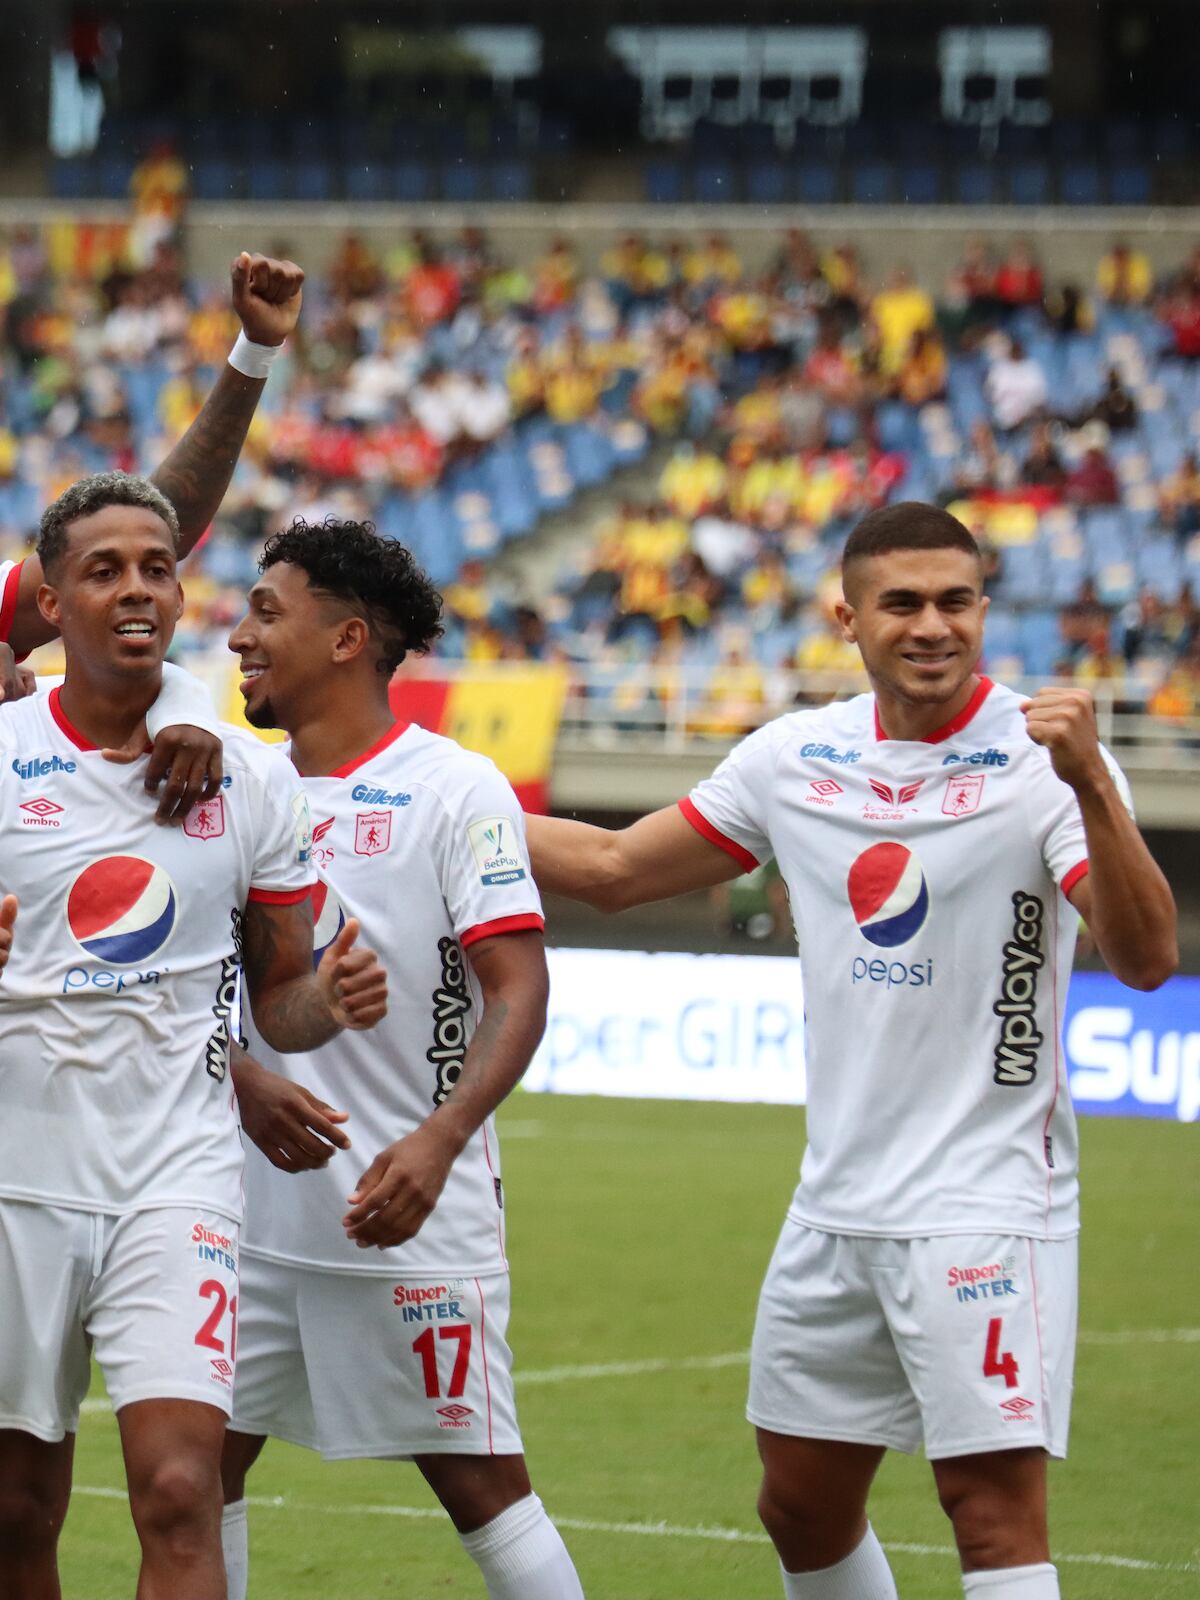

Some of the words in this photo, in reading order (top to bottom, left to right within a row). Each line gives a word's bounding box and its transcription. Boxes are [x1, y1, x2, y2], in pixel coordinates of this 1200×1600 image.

[351, 784, 412, 807] Gillette
[805, 795, 834, 807] umbro
[23, 817, 61, 828] umbro
[360, 817, 388, 827] América
[852, 956, 934, 990] pepsi
[994, 890, 1044, 1086] wplay.co
[547, 1010, 662, 1092] per
[677, 998, 792, 1070] GIR
[199, 1245, 238, 1276] INTER
[947, 1264, 1001, 1286] Super
[394, 1285, 447, 1306] Super
[957, 1279, 1020, 1302] INTER
[402, 1301, 466, 1323] INTER
[412, 1324, 472, 1399] 17
[983, 1317, 1020, 1389] 4
[440, 1420, 471, 1429] umbro
[1003, 1414, 1033, 1422] umbro
